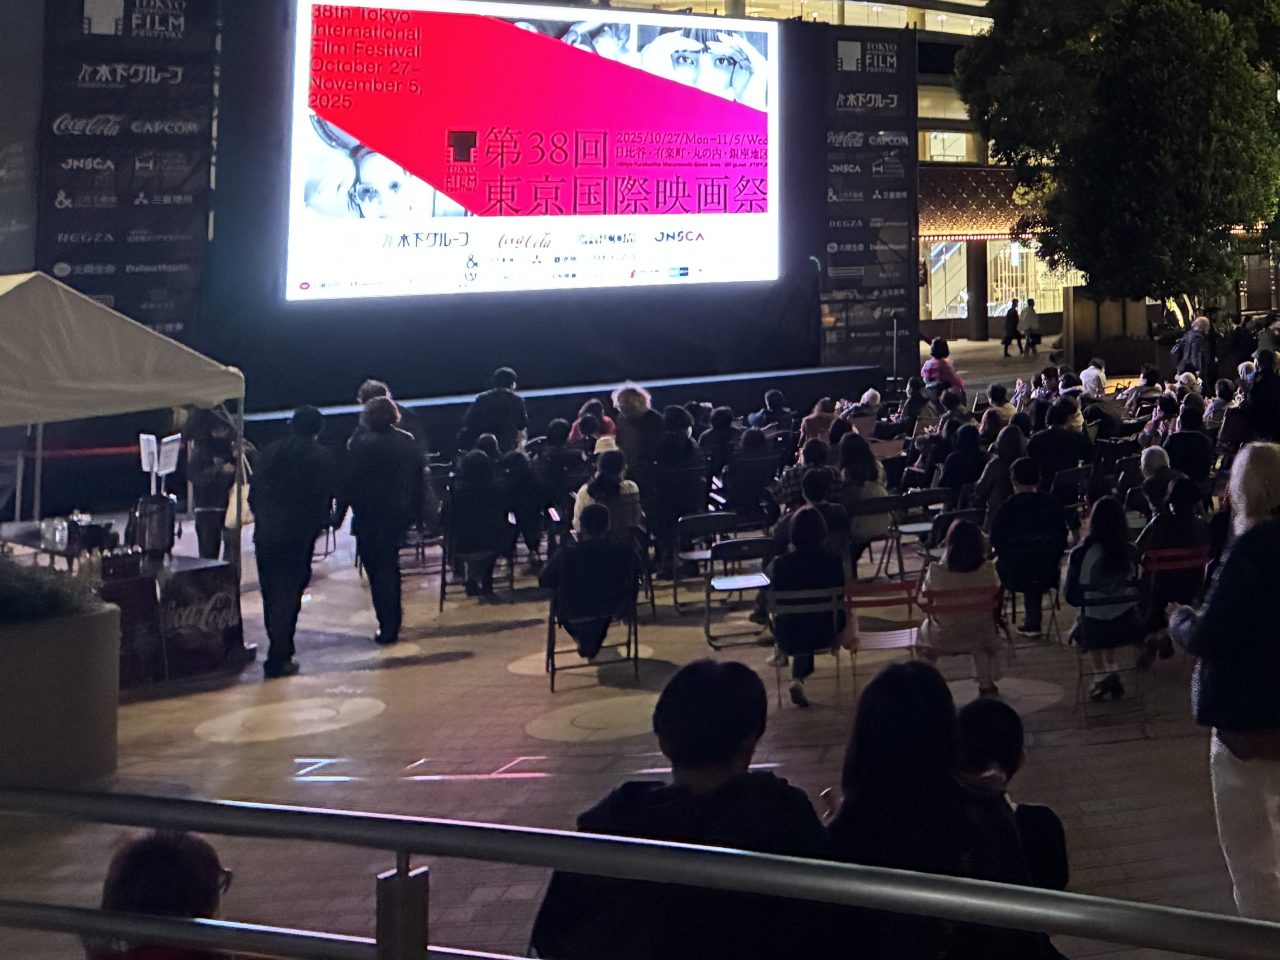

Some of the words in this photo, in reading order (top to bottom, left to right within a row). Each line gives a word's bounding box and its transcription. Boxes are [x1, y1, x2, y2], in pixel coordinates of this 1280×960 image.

[132, 13, 185, 32] FILM
[312, 5, 352, 19] 38th
[361, 7, 411, 26] Tokyo
[312, 21, 421, 41] International
[311, 39, 348, 55] Film
[354, 41, 421, 58] Festival
[866, 42, 897, 51] TOKYO
[311, 56, 382, 74] October
[865, 54, 897, 68] FILM
[311, 76, 402, 92] November
[409, 79, 424, 95] 5,
[309, 93, 353, 109] 2025
[130, 120, 198, 134] CAPCOM
[484, 126, 608, 169] 第38回
[869, 135, 909, 145] CAPCOM
[480, 174, 767, 215] 東京国際映画祭
